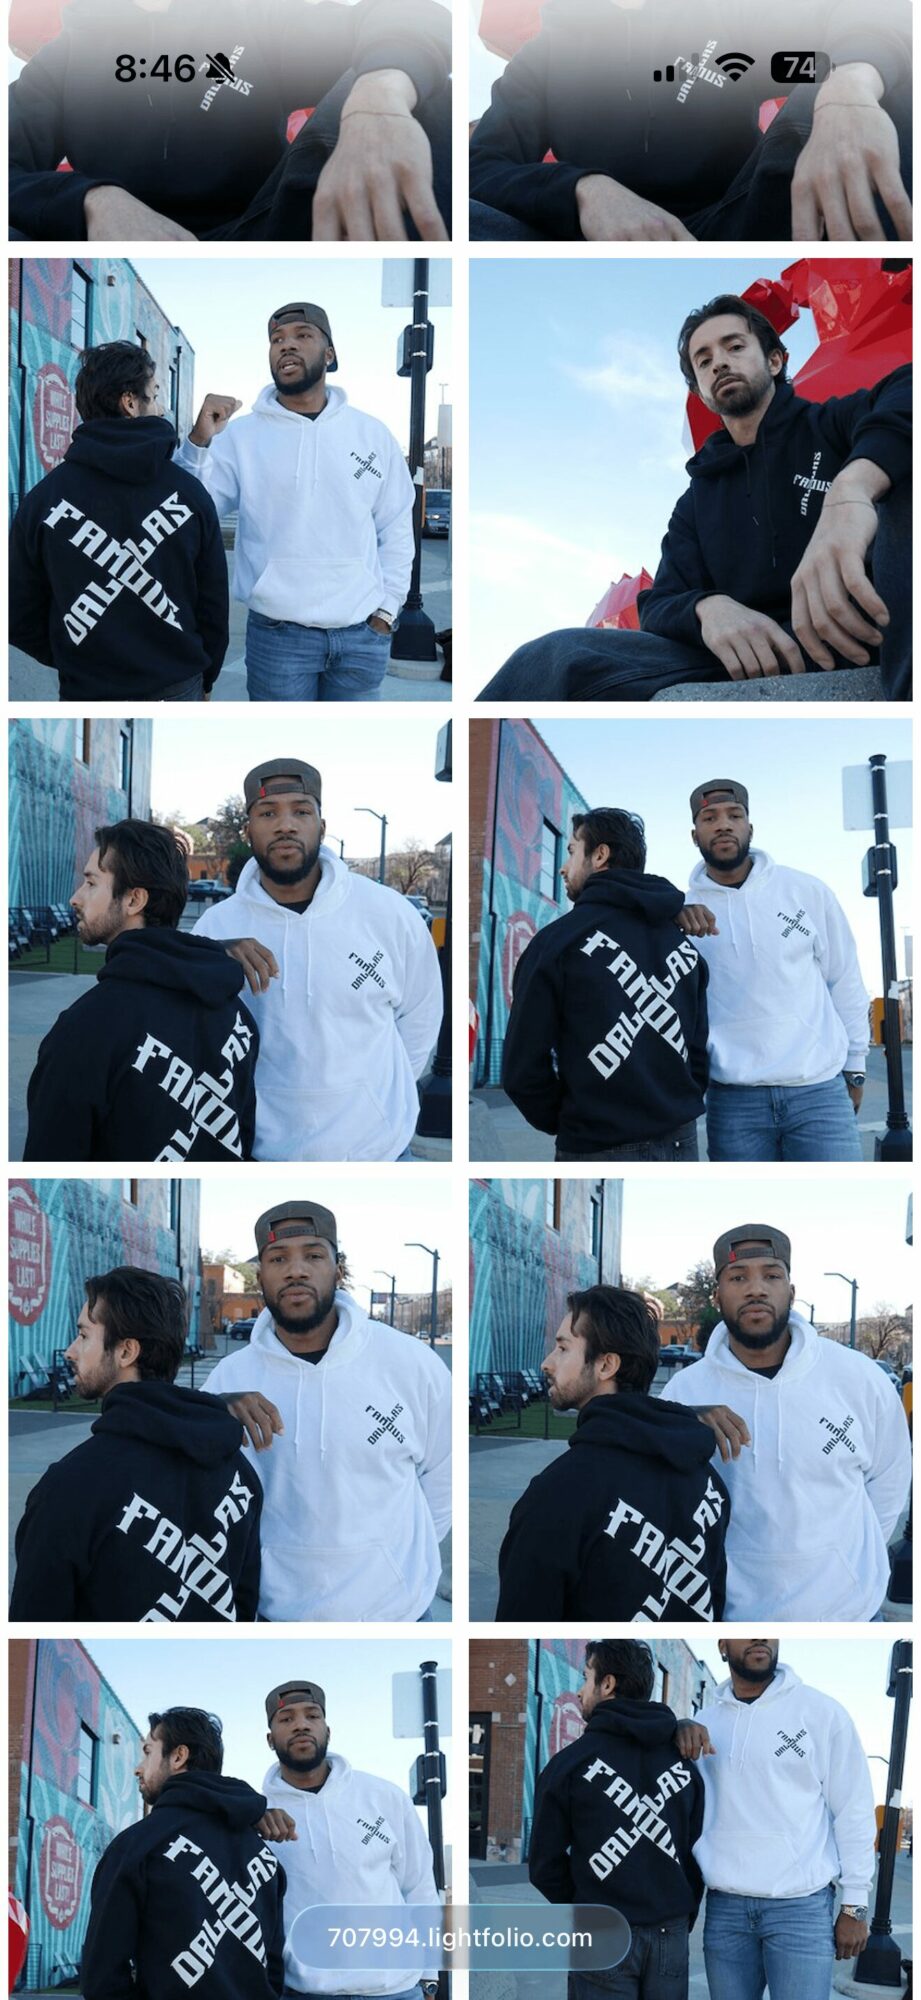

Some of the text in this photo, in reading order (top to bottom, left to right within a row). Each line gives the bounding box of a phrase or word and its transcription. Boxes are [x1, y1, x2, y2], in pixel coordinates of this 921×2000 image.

[63, 491, 194, 646] DALLAS
[588, 940, 699, 1080] DALLAS
[588, 1761, 692, 1881] DALLAS
[170, 1847, 278, 1989] DALLAS
